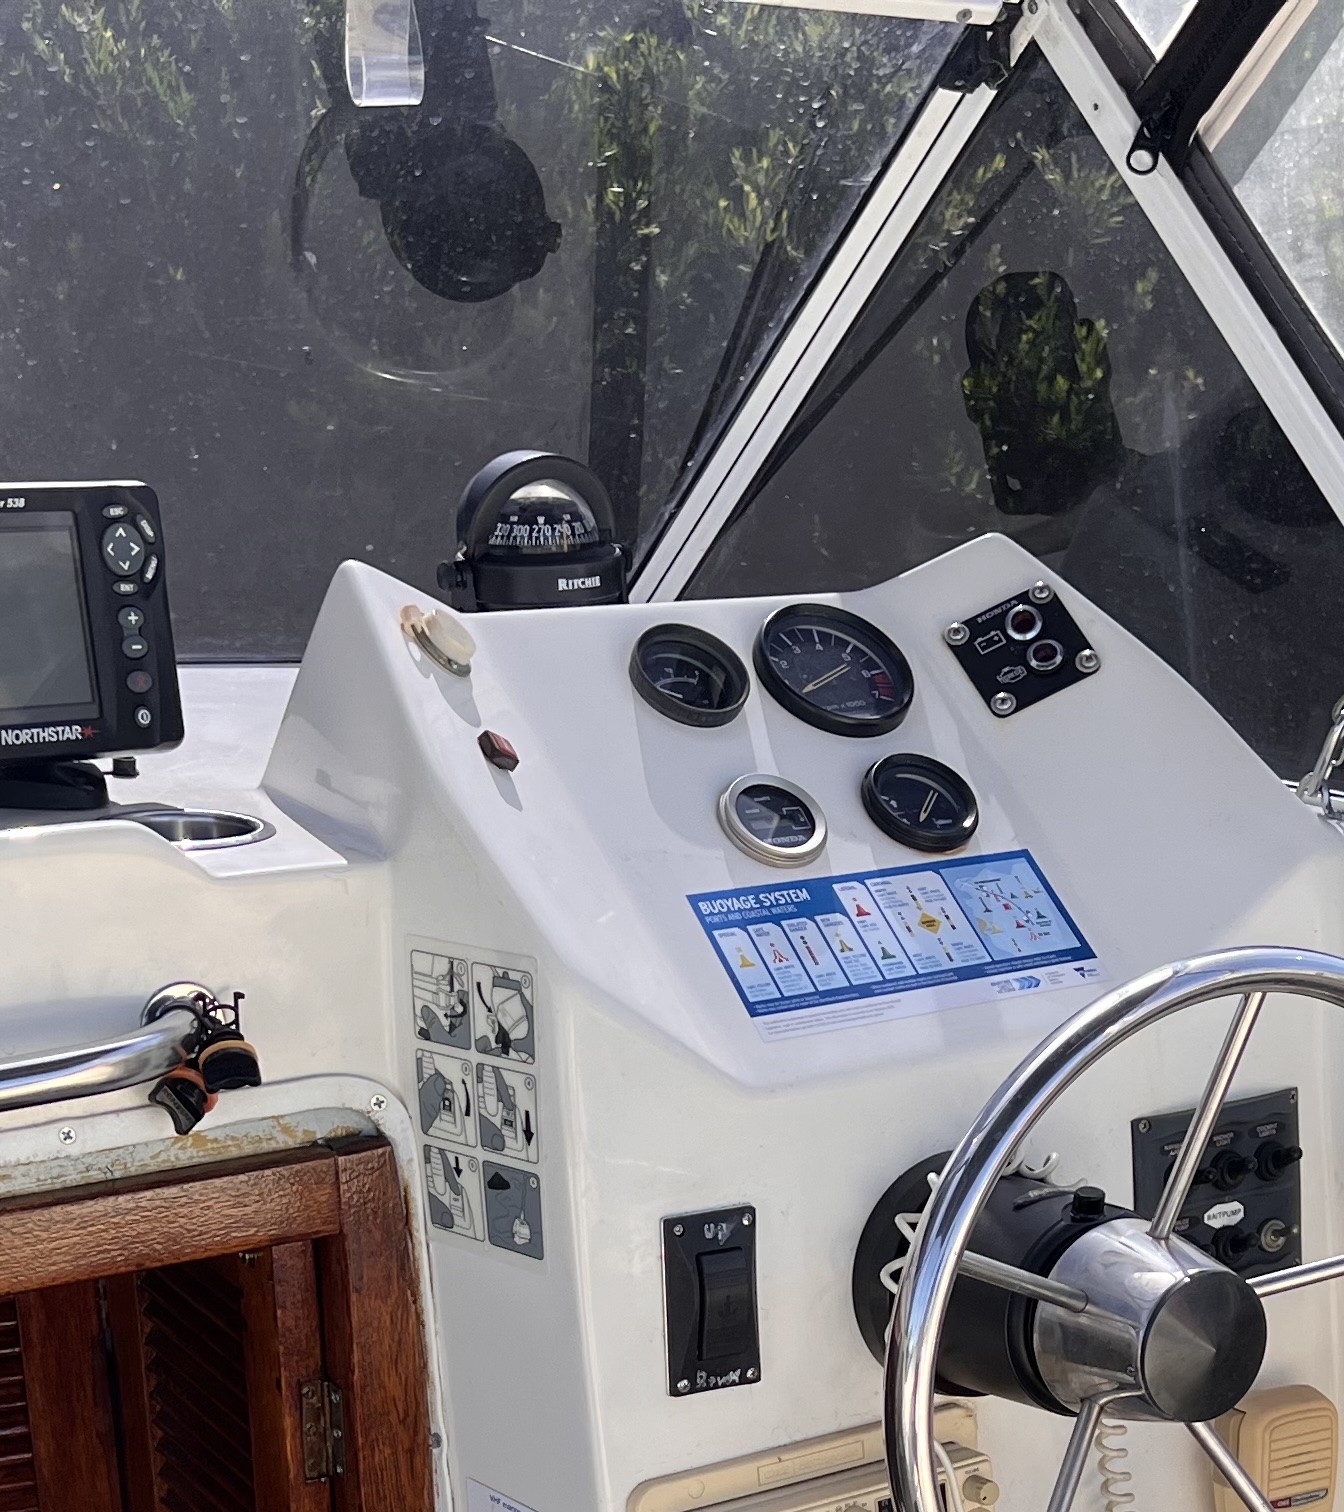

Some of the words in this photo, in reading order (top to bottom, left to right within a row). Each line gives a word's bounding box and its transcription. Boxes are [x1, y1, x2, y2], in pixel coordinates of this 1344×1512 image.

[7, 497, 25, 508] 538
[109, 507, 124, 516] ESC
[511, 524, 530, 537] 300
[532, 524, 551, 537] 270
[558, 576, 601, 591] RITCHIE
[976, 600, 1020, 624] HONDA
[791, 646, 801, 655] 3
[815, 643, 824, 651] 4
[1, 725, 83, 746] NORTHSTAR
[698, 895, 760, 915] BUOYAGE
[759, 888, 811, 906] SYSTEM
[727, 912, 742, 921] AND
[742, 907, 772, 919] COASTAL
[1207, 1208, 1241, 1220] BAITPUMP
